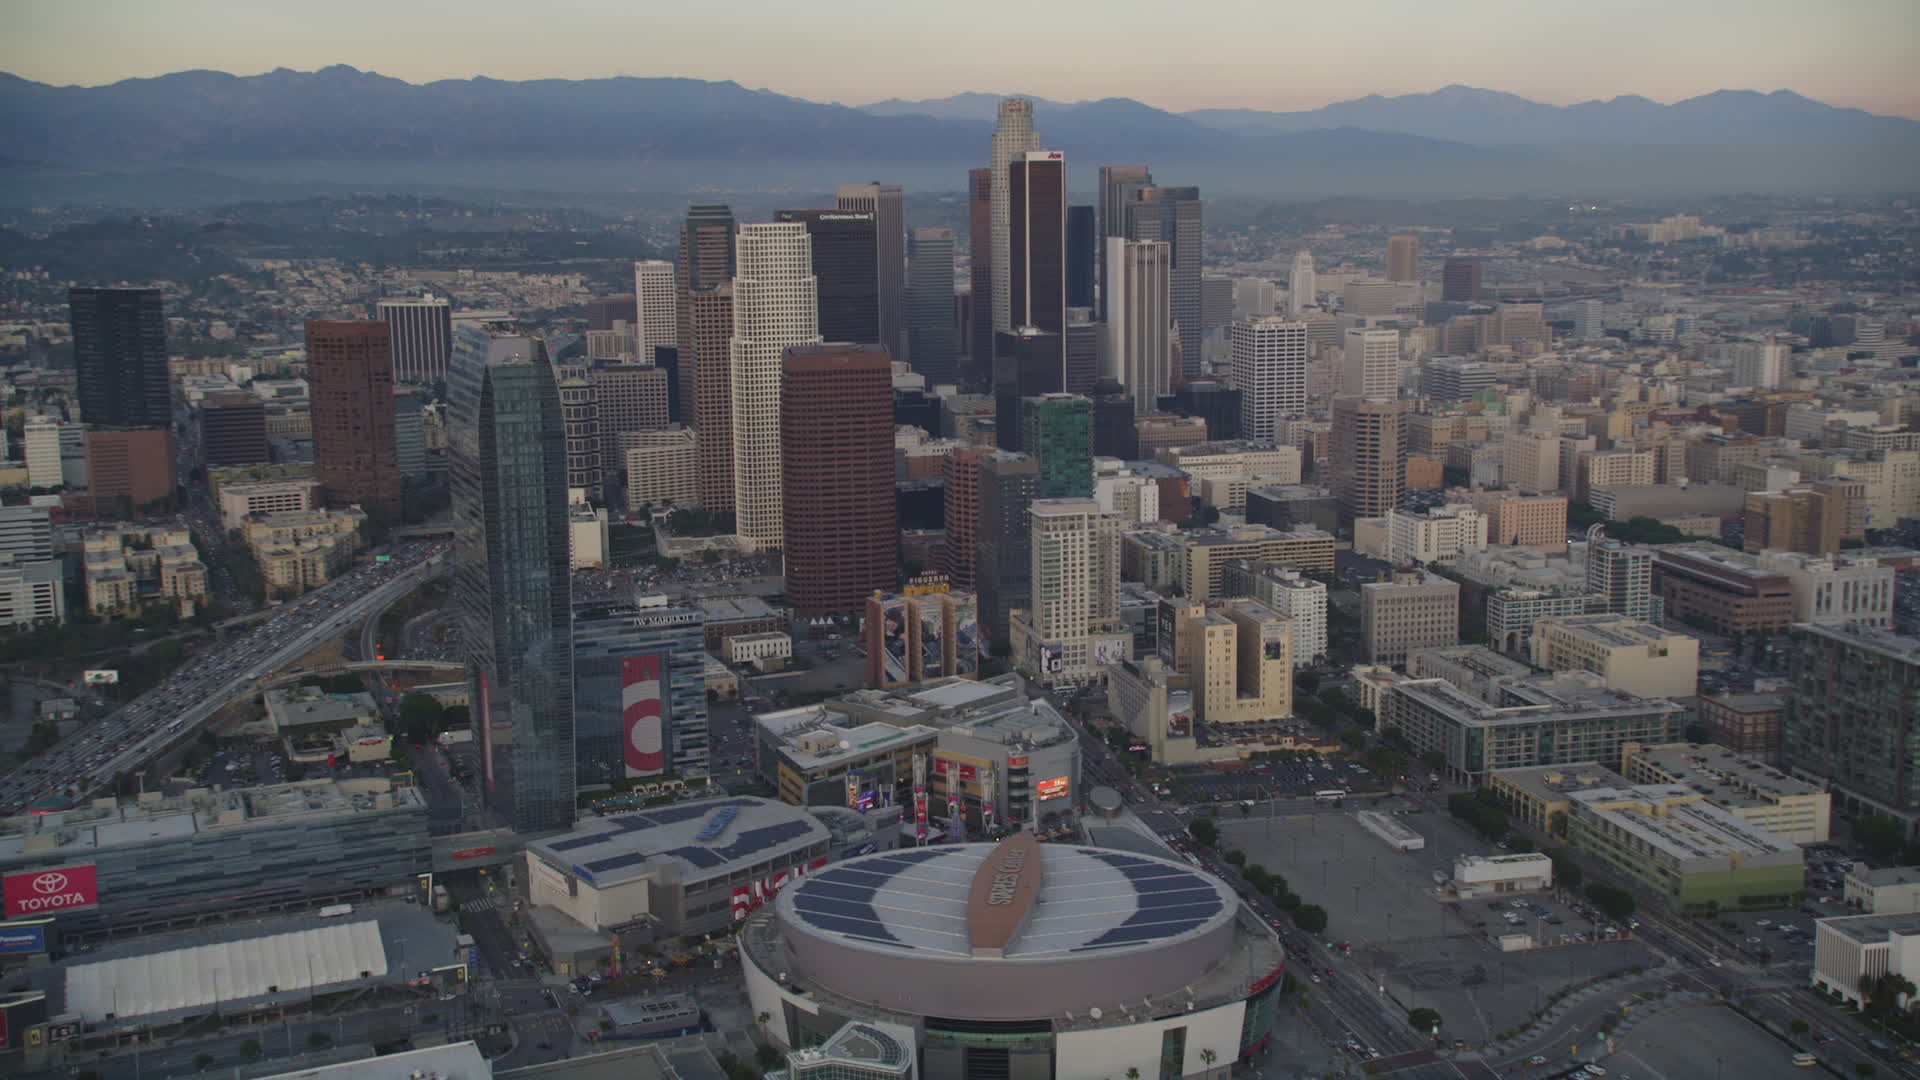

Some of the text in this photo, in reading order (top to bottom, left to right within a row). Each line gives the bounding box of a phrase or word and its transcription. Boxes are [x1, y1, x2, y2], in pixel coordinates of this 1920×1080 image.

[633, 614, 697, 628] JW MARRIOTT
[986, 872, 1018, 904] STAPLES
[18, 892, 85, 911] TOYOTA
